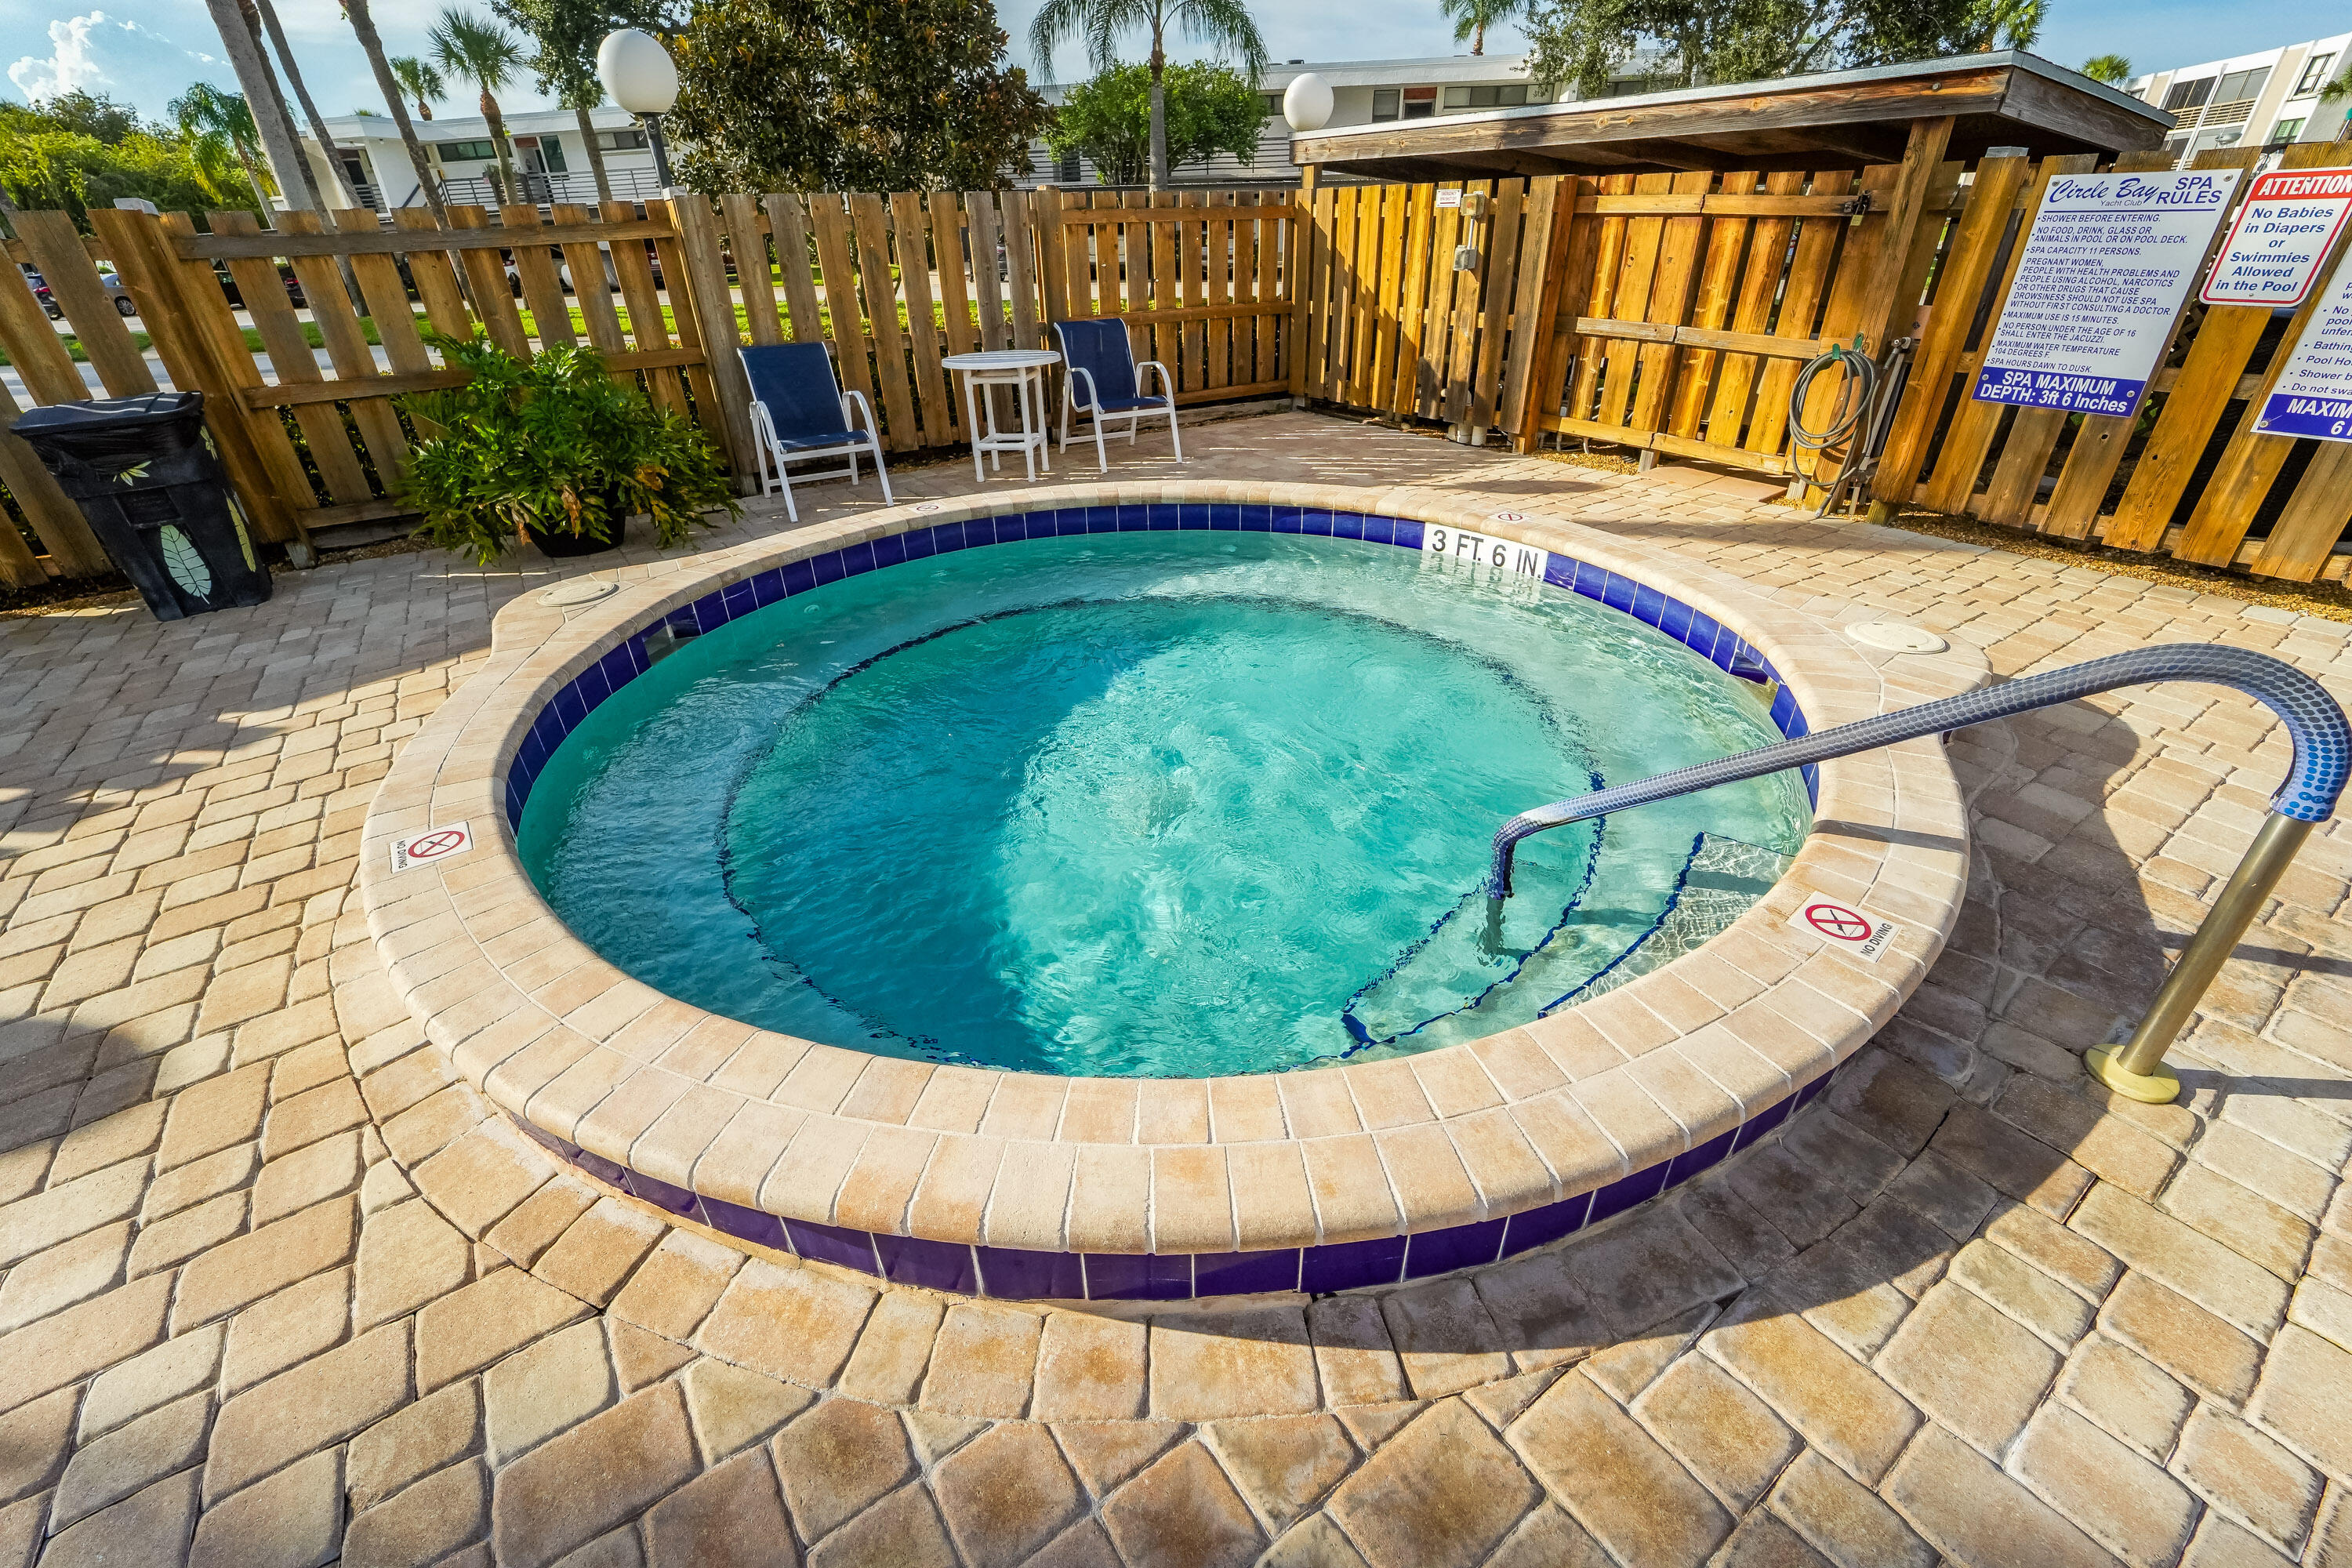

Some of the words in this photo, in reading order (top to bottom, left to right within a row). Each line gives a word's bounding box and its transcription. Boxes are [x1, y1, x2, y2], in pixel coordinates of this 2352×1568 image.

[2176, 176, 2212, 190] SPA
[2049, 180, 2109, 202] Circle
[2116, 178, 2159, 203] Bay
[2156, 191, 2222, 204] RULES
[2252, 208, 2272, 218] No
[2277, 207, 2334, 218] Babies
[2245, 223, 2259, 233] in
[2263, 223, 2325, 235] Diapers
[2230, 252, 2310, 263] Swimmies
[2232, 266, 2294, 277] Allowed
[2078, 277, 2119, 286] ALCOHOL,
[2122, 278, 2174, 287] NARCOTICS
[2216, 280, 2229, 290] in
[2234, 281, 2257, 290] the
[2262, 281, 2297, 292] Pool
[2014, 292, 2065, 301] DROWSINESS
[2071, 303, 2124, 313] CONSULTING
[2133, 307, 2171, 315] DOCTOR.
[2082, 315, 2118, 325] MINUTES.
[2049, 325, 2075, 333] UNDER
[2070, 335, 2104, 343] JACUZZI.
[1997, 340, 2032, 349] MAXIMUM
[2034, 343, 2060, 351] WATER
[2061, 345, 2121, 355] TEMPERATURE
[2008, 349, 2043, 358] DEGREES
[2306, 355, 2332, 364] Pool
[2005, 359, 2032, 368] HOURS
[2069, 365, 2092, 373] DUSK.
[2299, 369, 2343, 379] Shower
[2002, 371, 2031, 387] SPA
[2035, 374, 2117, 396] MAXIMUM
[1980, 383, 2036, 402] DEPTH:
[2038, 390, 2059, 405] 3ft
[2062, 392, 2071, 406] 6
[2074, 394, 2128, 412] Inches
[2331, 420, 2345, 435] 6
[1432, 529, 1446, 552] 3
[1456, 533, 1484, 561] FT.
[1492, 544, 1507, 568] 6
[1516, 549, 1541, 579] IN.
[397, 849, 408, 869] DIVING
[1860, 945, 1875, 956] NO
[1869, 924, 1893, 946] DIVING
